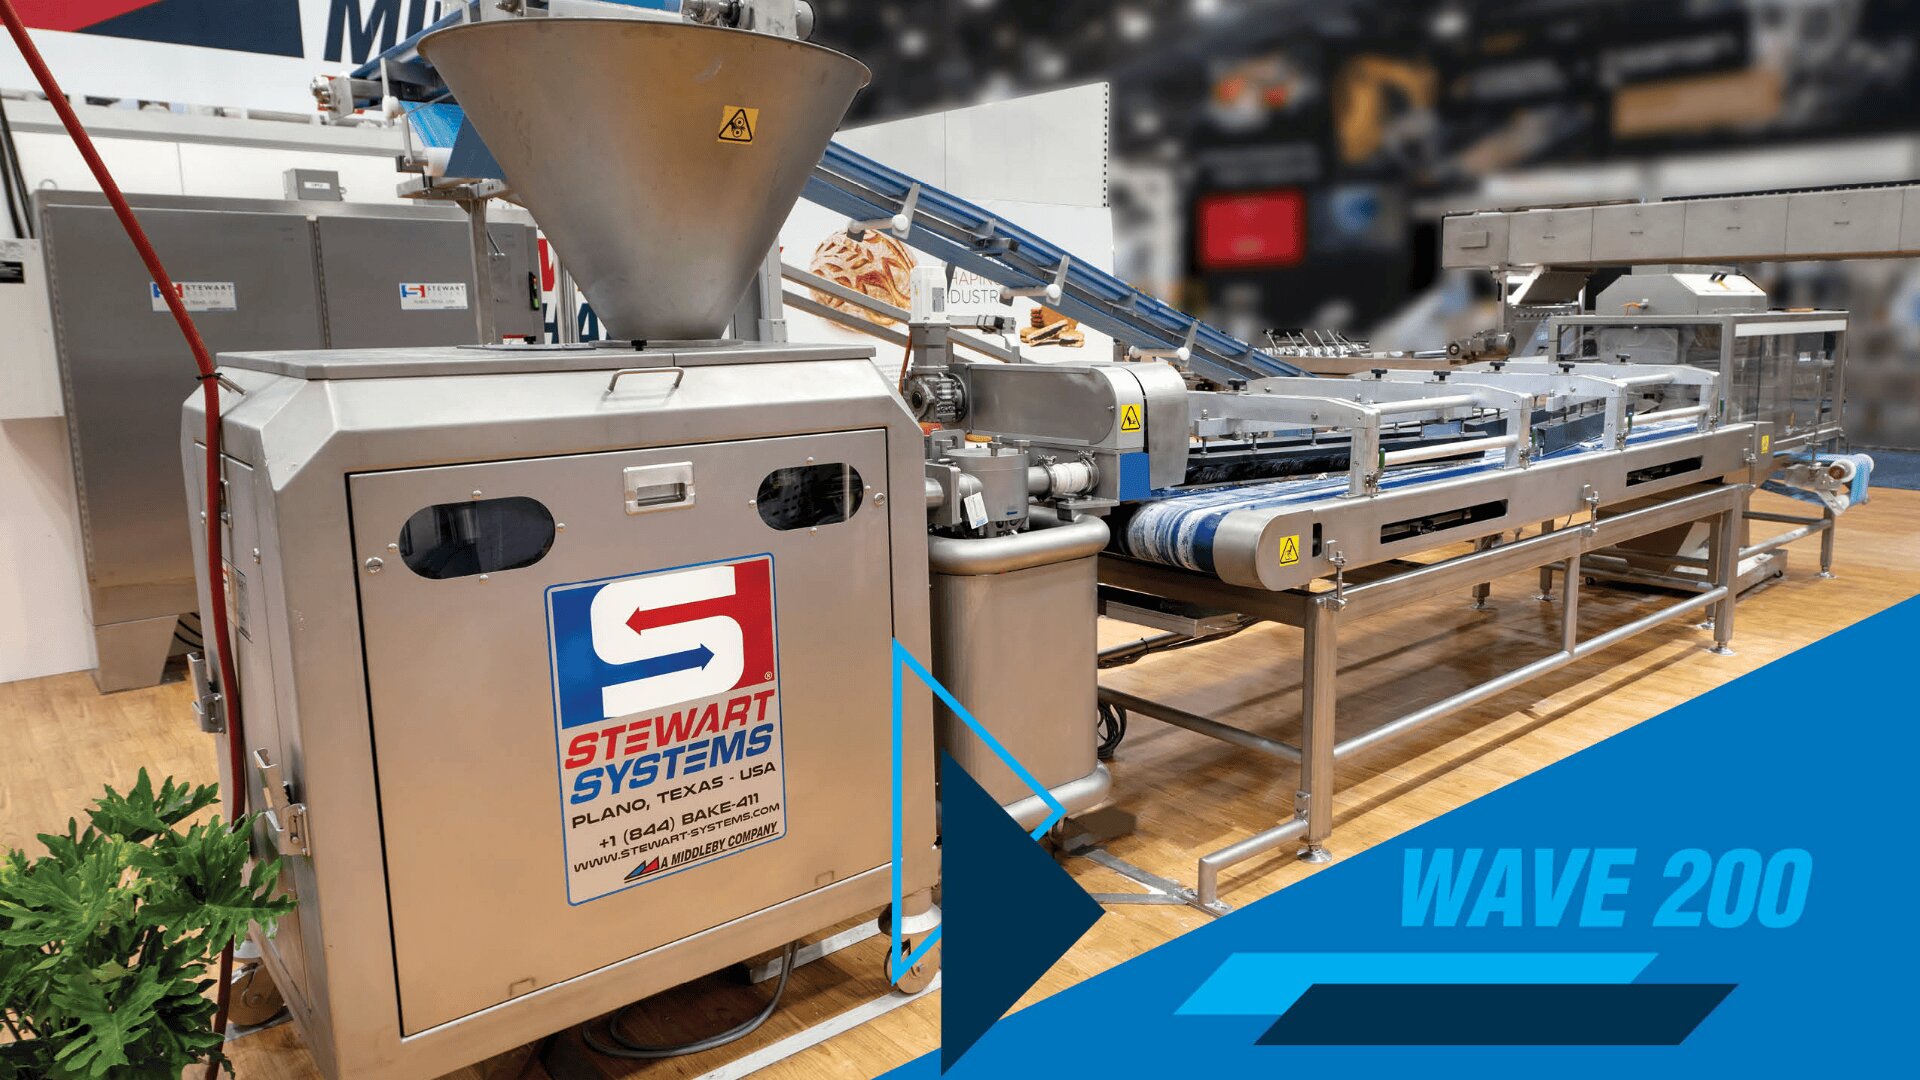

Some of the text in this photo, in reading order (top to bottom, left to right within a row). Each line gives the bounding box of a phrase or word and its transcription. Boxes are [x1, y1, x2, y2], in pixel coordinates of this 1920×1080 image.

[324, 0, 441, 64] MI
[946, 289, 999, 304] DUSTR
[564, 688, 775, 770] STEWART
[570, 723, 774, 805] SYSTEMS
[572, 798, 651, 829] PLANO,
[656, 775, 724, 804] TEXAS
[740, 761, 776, 781] USA
[574, 802, 780, 873] WWW.STEWART-SYSTEMS.COM
[599, 792, 759, 849] +1 (844) BAKE-411
[661, 821, 778, 869] A MIDDLEBY COMPANY
